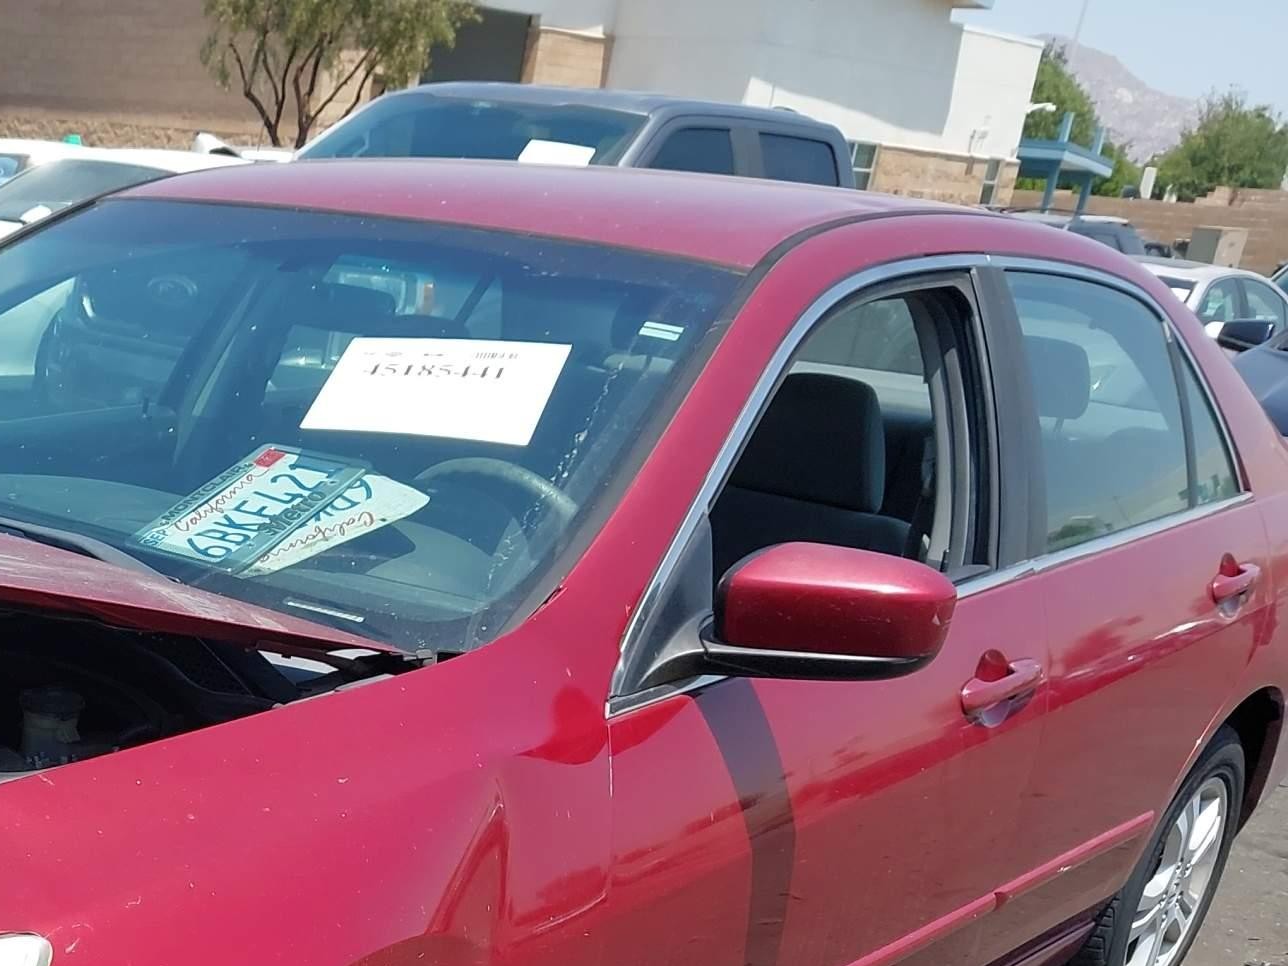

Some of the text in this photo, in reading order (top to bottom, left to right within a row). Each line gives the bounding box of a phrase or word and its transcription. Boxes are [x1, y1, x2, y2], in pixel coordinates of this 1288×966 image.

[165, 465, 244, 523] MONTCLAIR
[174, 470, 268, 533] California
[143, 529, 168, 546] SEP
